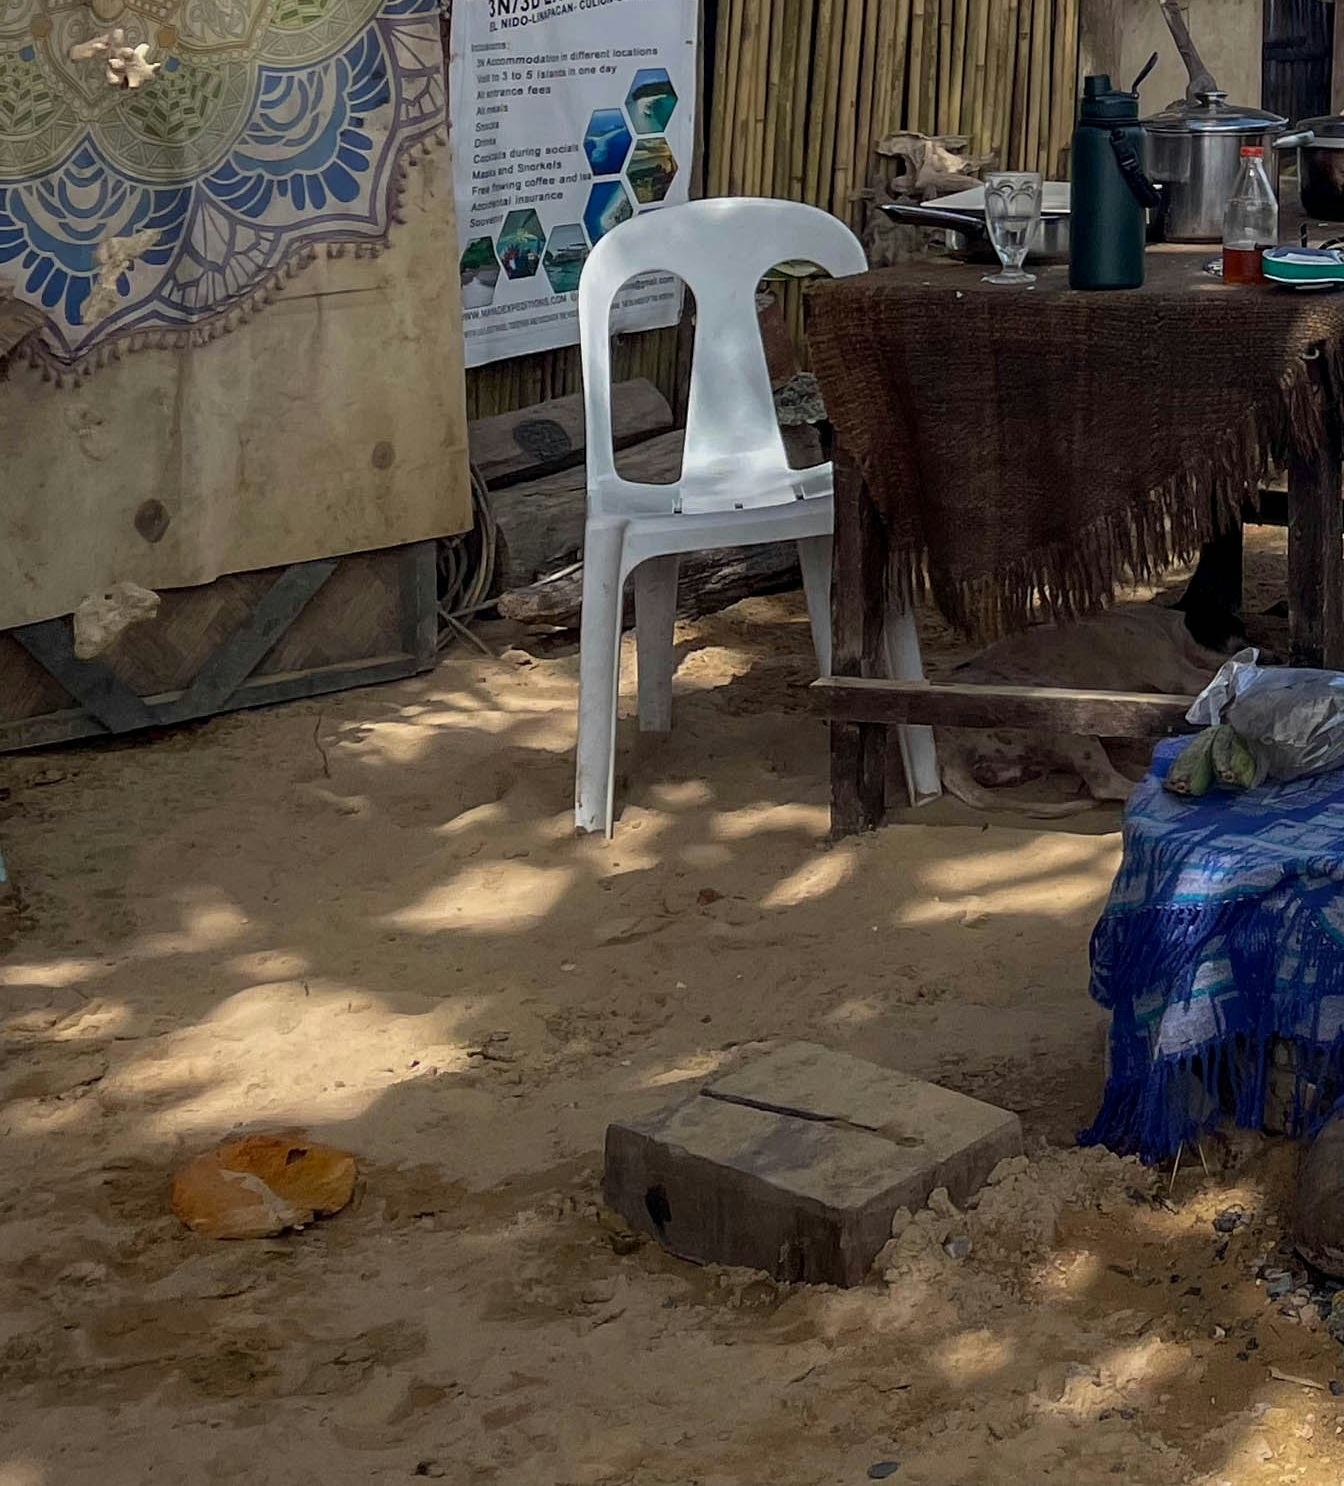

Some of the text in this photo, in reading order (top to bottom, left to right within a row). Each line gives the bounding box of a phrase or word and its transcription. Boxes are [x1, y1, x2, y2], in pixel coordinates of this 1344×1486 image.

[570, 49, 610, 61] different
[612, 46, 658, 57] locations
[511, 71, 521, 81] to
[525, 70, 533, 80] 5
[578, 67, 596, 76] one
[599, 64, 617, 75] day
[527, 85, 551, 95] fees
[509, 146, 541, 159] during
[517, 160, 562, 173] Snorkels
[524, 176, 556, 188] coffee
[559, 173, 578, 184] and
[515, 191, 563, 204] insurance
